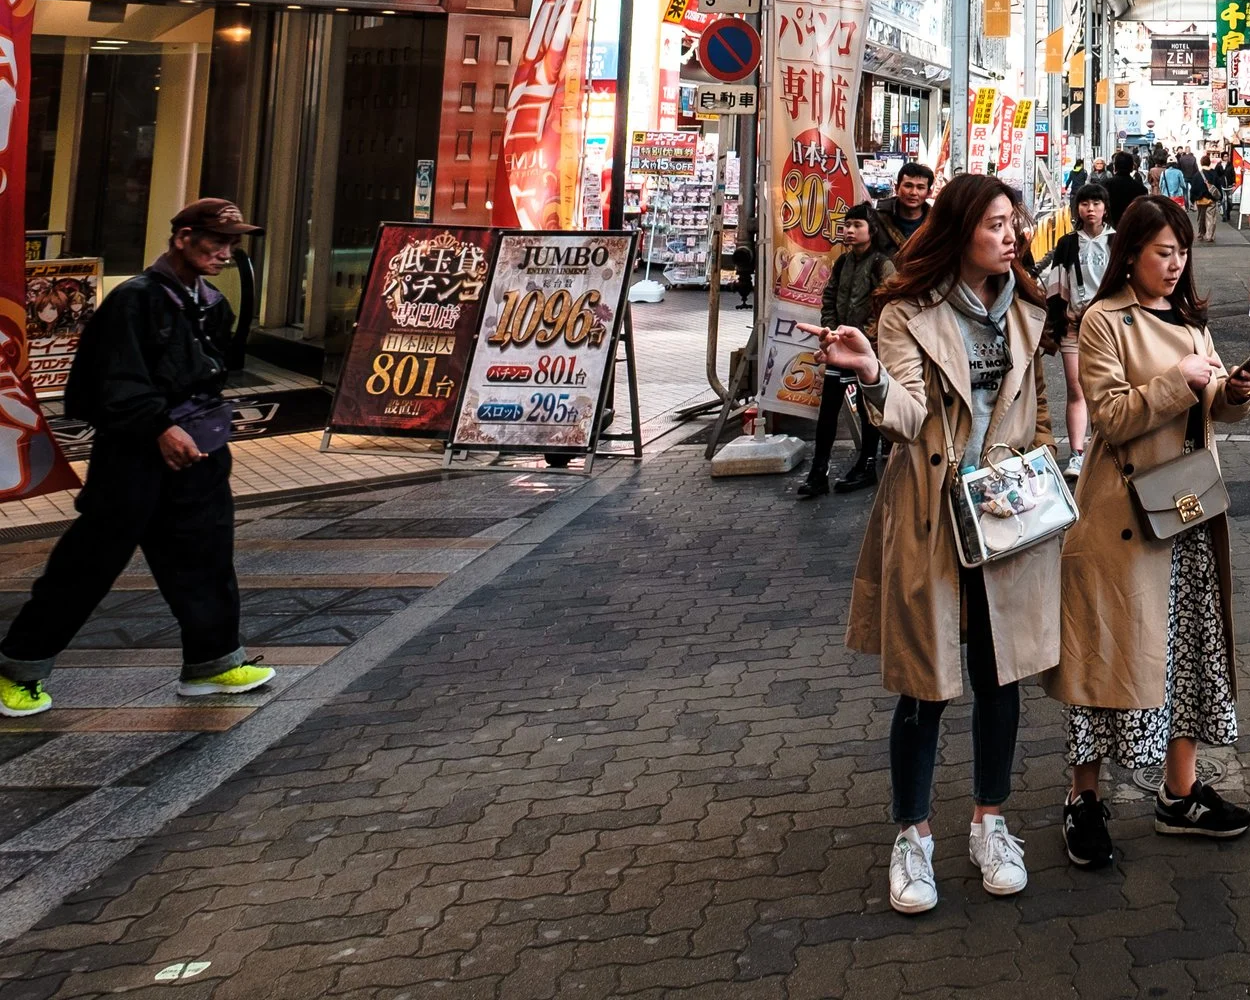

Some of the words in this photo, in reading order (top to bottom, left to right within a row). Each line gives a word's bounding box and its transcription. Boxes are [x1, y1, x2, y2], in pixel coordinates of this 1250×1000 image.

[1167, 52, 1194, 65] ZEN
[701, 91, 754, 108] 自動車
[780, 66, 850, 131] 専門店
[1004, 104, 1015, 120] Tax
[1001, 142, 1011, 163] Shop
[399, 246, 484, 274] 低玉貸
[518, 245, 609, 270] JUMBO
[527, 267, 588, 275] ENTERTAINMENT
[381, 274, 484, 303] パチンコ
[395, 302, 461, 329] 専門店
[384, 336, 455, 354] 日本最大
[365, 354, 455, 399] 801台
[487, 367, 531, 382] パチンコ
[534, 355, 588, 386] 801台
[969, 360, 983, 370] HE
[480, 404, 523, 420] スロット
[526, 392, 579, 423] 295台
